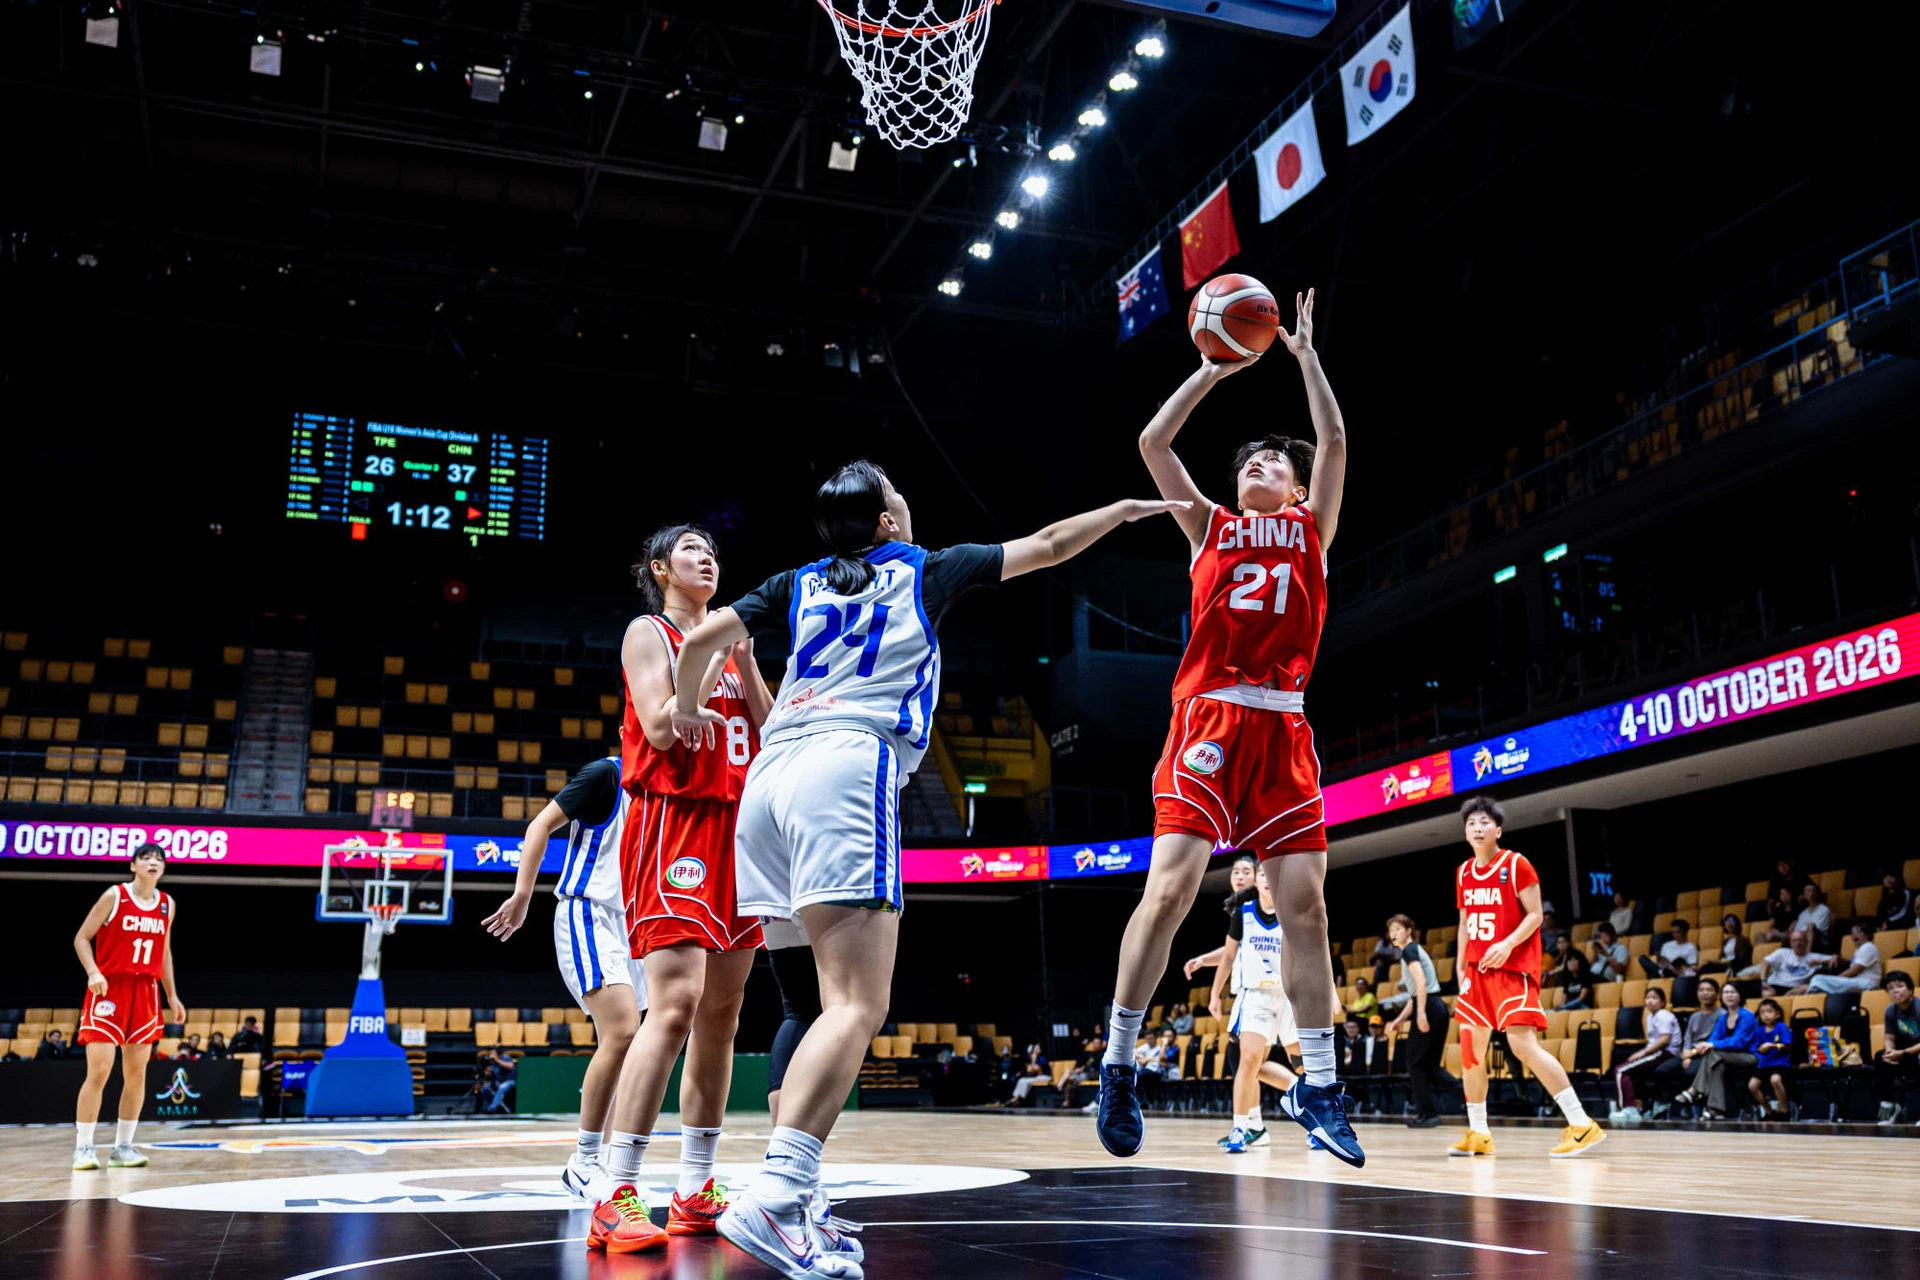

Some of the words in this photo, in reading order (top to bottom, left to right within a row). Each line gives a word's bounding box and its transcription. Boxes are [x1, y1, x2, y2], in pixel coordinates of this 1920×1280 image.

[373, 436, 397, 448] TPE
[448, 443, 473, 456] CHN
[364, 455, 395, 476] 26
[447, 463, 477, 484] 37
[387, 501, 451, 530] 1:12
[470, 534, 478, 548] 1
[1217, 517, 1306, 553] CHINA
[1229, 563, 1291, 614] 21
[795, 602, 893, 682] 24
[1619, 693, 1673, 742] 4-10
[1677, 655, 1808, 728] OCTOBER
[1812, 627, 1901, 693] 2026
[14, 824, 147, 857] OCTOBER
[153, 828, 228, 860] 2026
[673, 865, 701, 879] 伊利
[1463, 887, 1502, 906] CHINA
[122, 915, 165, 935] CHINA
[1467, 912, 1496, 941] 45
[132, 938, 154, 965] 11
[1249, 936, 1282, 946] CHINES
[350, 1016, 385, 1033] FIBA
